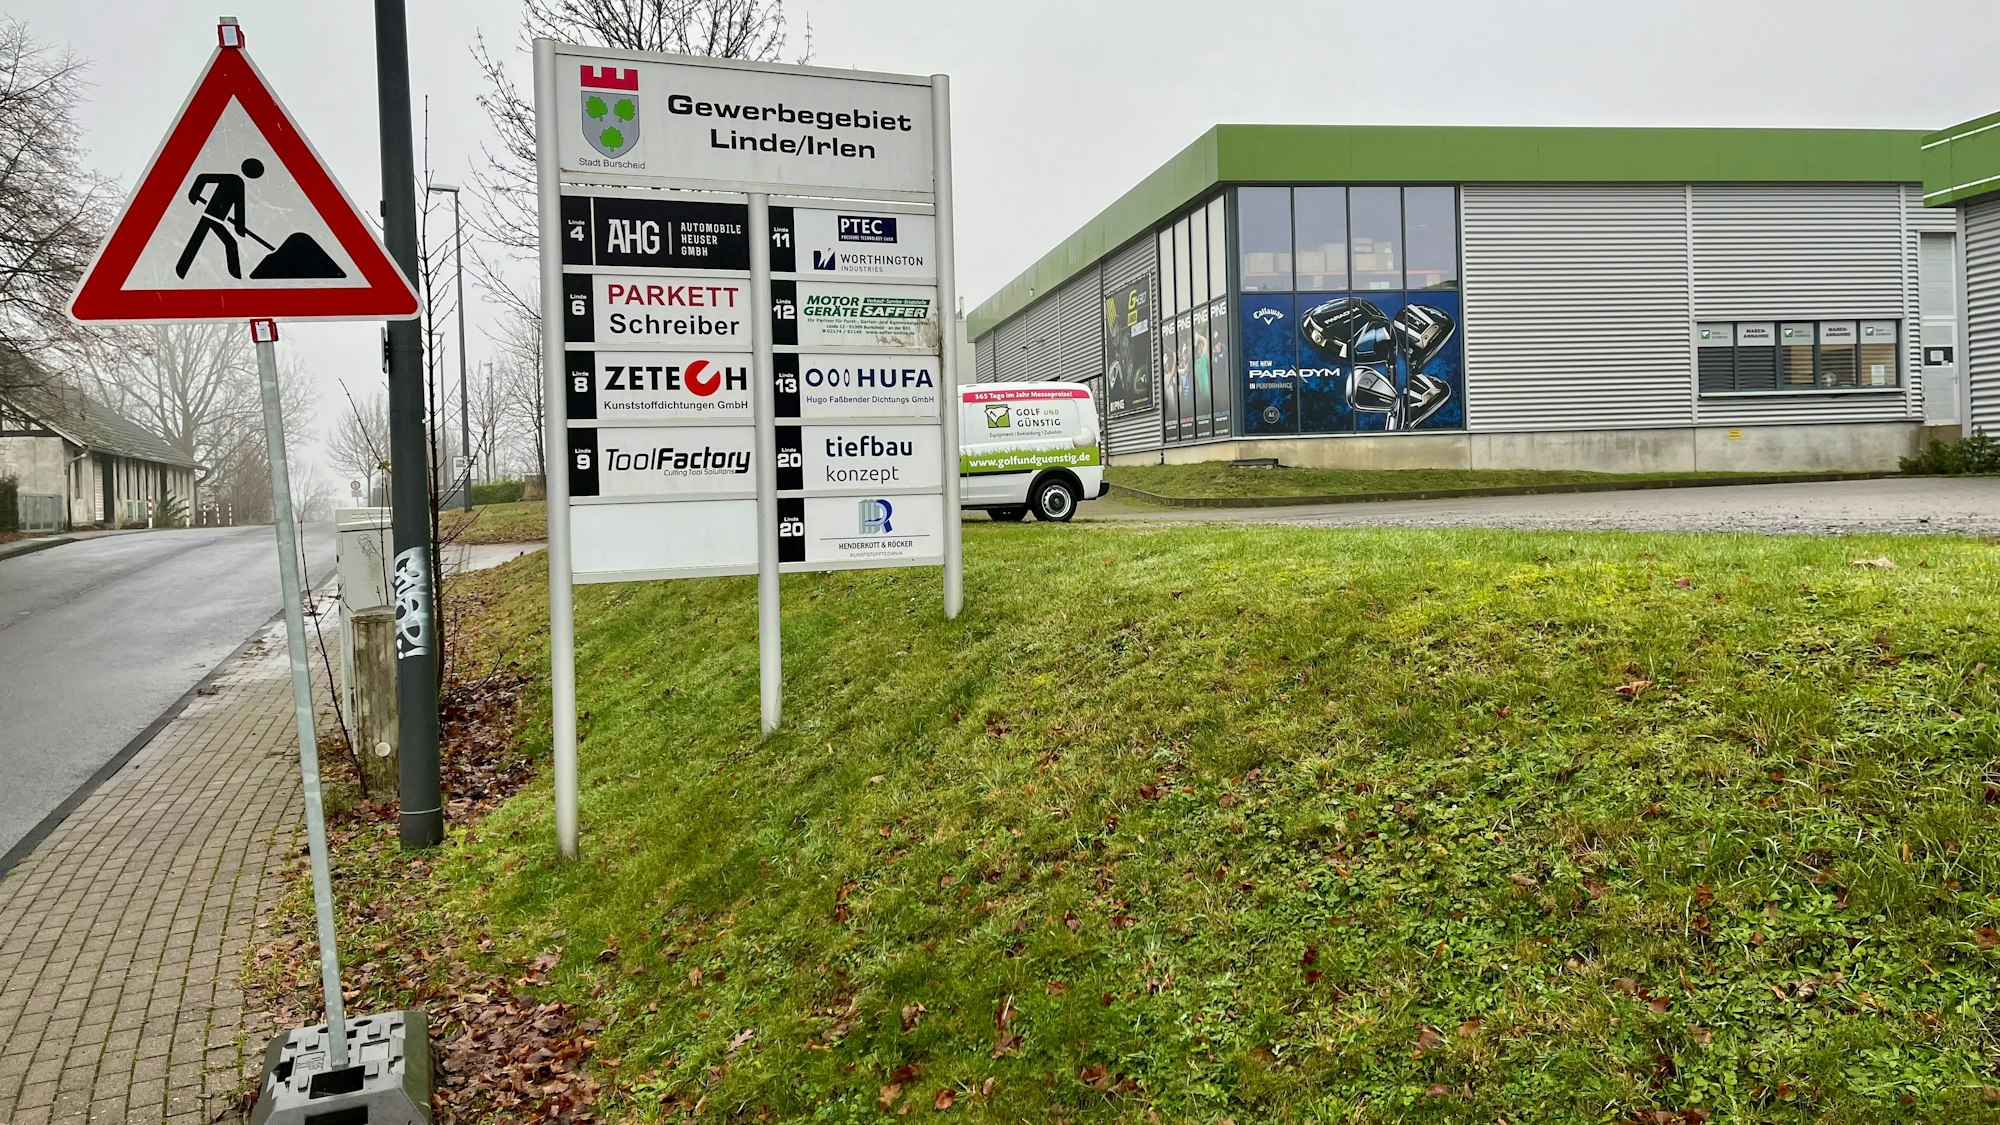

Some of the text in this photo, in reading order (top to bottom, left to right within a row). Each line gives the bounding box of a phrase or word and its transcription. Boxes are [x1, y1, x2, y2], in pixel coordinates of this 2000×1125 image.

[667, 94, 913, 132] Gewerbegebiet
[710, 128, 876, 159] Linde/Irlen
[579, 157, 646, 169] Stadt Burscheid
[570, 226, 585, 241] 4
[680, 222, 742, 235] AUTOMOBILE
[840, 218, 883, 234] PTEC
[607, 219, 661, 255] AHG
[681, 234, 719, 245] HEUSER
[772, 233, 790, 248] 11
[681, 246, 709, 257] GMBH
[840, 254, 924, 266] WORTHINGTON
[841, 265, 883, 273] INDUSTRIES
[608, 284, 739, 307] PARKETT
[806, 295, 860, 306] MOTOR
[571, 300, 585, 316] 6
[773, 305, 795, 320] 12
[804, 305, 859, 317] GERÄTE
[862, 306, 926, 318] SAFFER
[1210, 301, 1227, 317] PING
[1252, 307, 1285, 320] Callaway
[609, 313, 740, 335] Schreiber
[1177, 316, 1191, 332] PING
[1193, 309, 1208, 326] PING
[1162, 322, 1176, 338] PING
[604, 360, 747, 397] ZETECH
[857, 368, 934, 388] HUFA
[1249, 366, 1340, 381] PARADYM
[574, 377, 588, 393] 8
[775, 379, 797, 394] 13
[806, 395, 828, 405] Hugo
[829, 395, 870, 403] Faßbender
[872, 395, 909, 404] Dichtungs
[989, 392, 1005, 400] Tage
[1030, 391, 1073, 399] Messepreise!
[604, 400, 749, 411] Kunststoffdichtungen GmbH
[1016, 408, 1040, 416] GOLF
[1017, 417, 1061, 428] GÜNSTIG
[826, 435, 913, 457] tiefbau
[576, 454, 591, 470] 9
[605, 446, 751, 474] ToolFactory
[777, 453, 802, 468] 20
[969, 452, 1091, 469] www.golfundguenstig.de
[688, 468, 703, 476] Tool
[826, 465, 900, 484] konzept
[779, 522, 804, 537] 20
[838, 541, 881, 550] HENDERKOTT
[887, 540, 913, 548] RÖCKER
